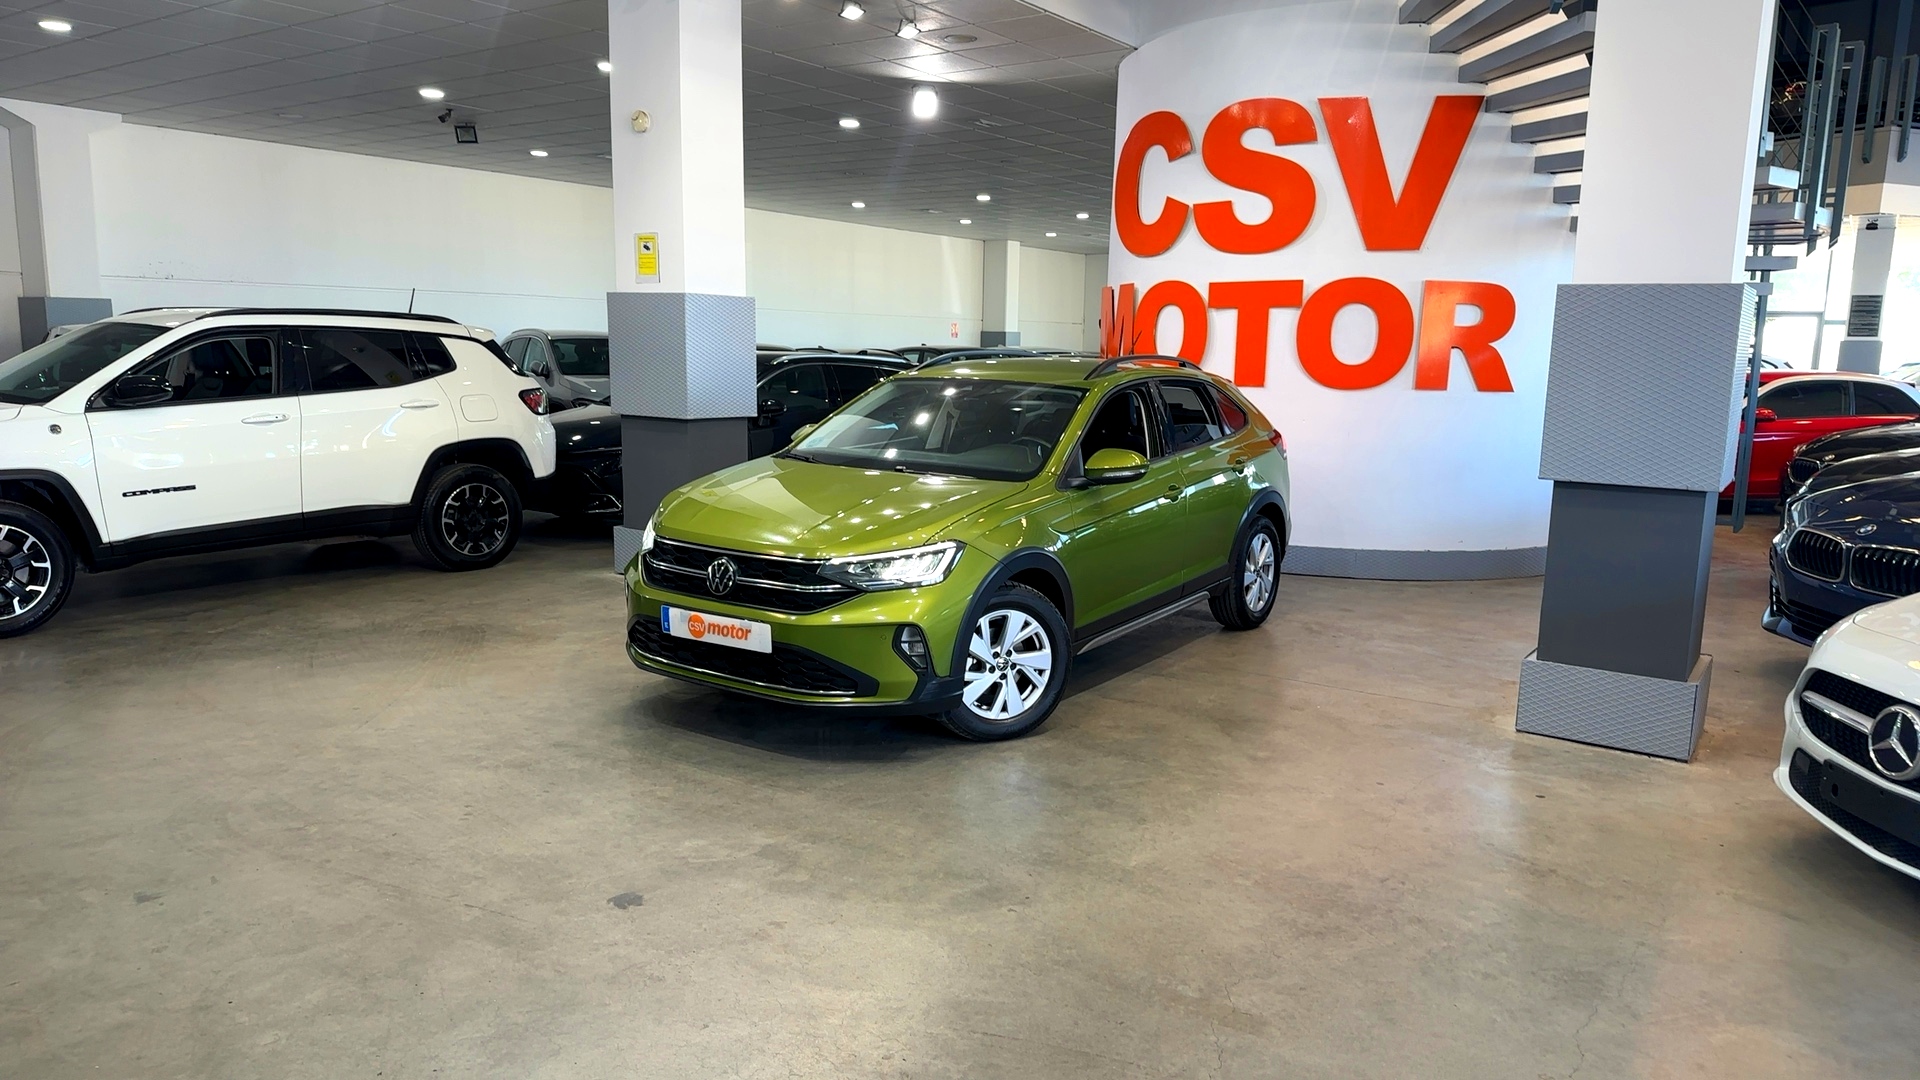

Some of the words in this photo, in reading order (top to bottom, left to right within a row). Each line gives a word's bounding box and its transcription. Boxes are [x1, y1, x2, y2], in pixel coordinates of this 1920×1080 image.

[1114, 95, 1485, 257] CSV
[1100, 277, 1516, 392] MOTOR
[122, 485, 196, 497] COMPASS
[688, 620, 705, 632] CSV
[707, 622, 751, 640] motor
